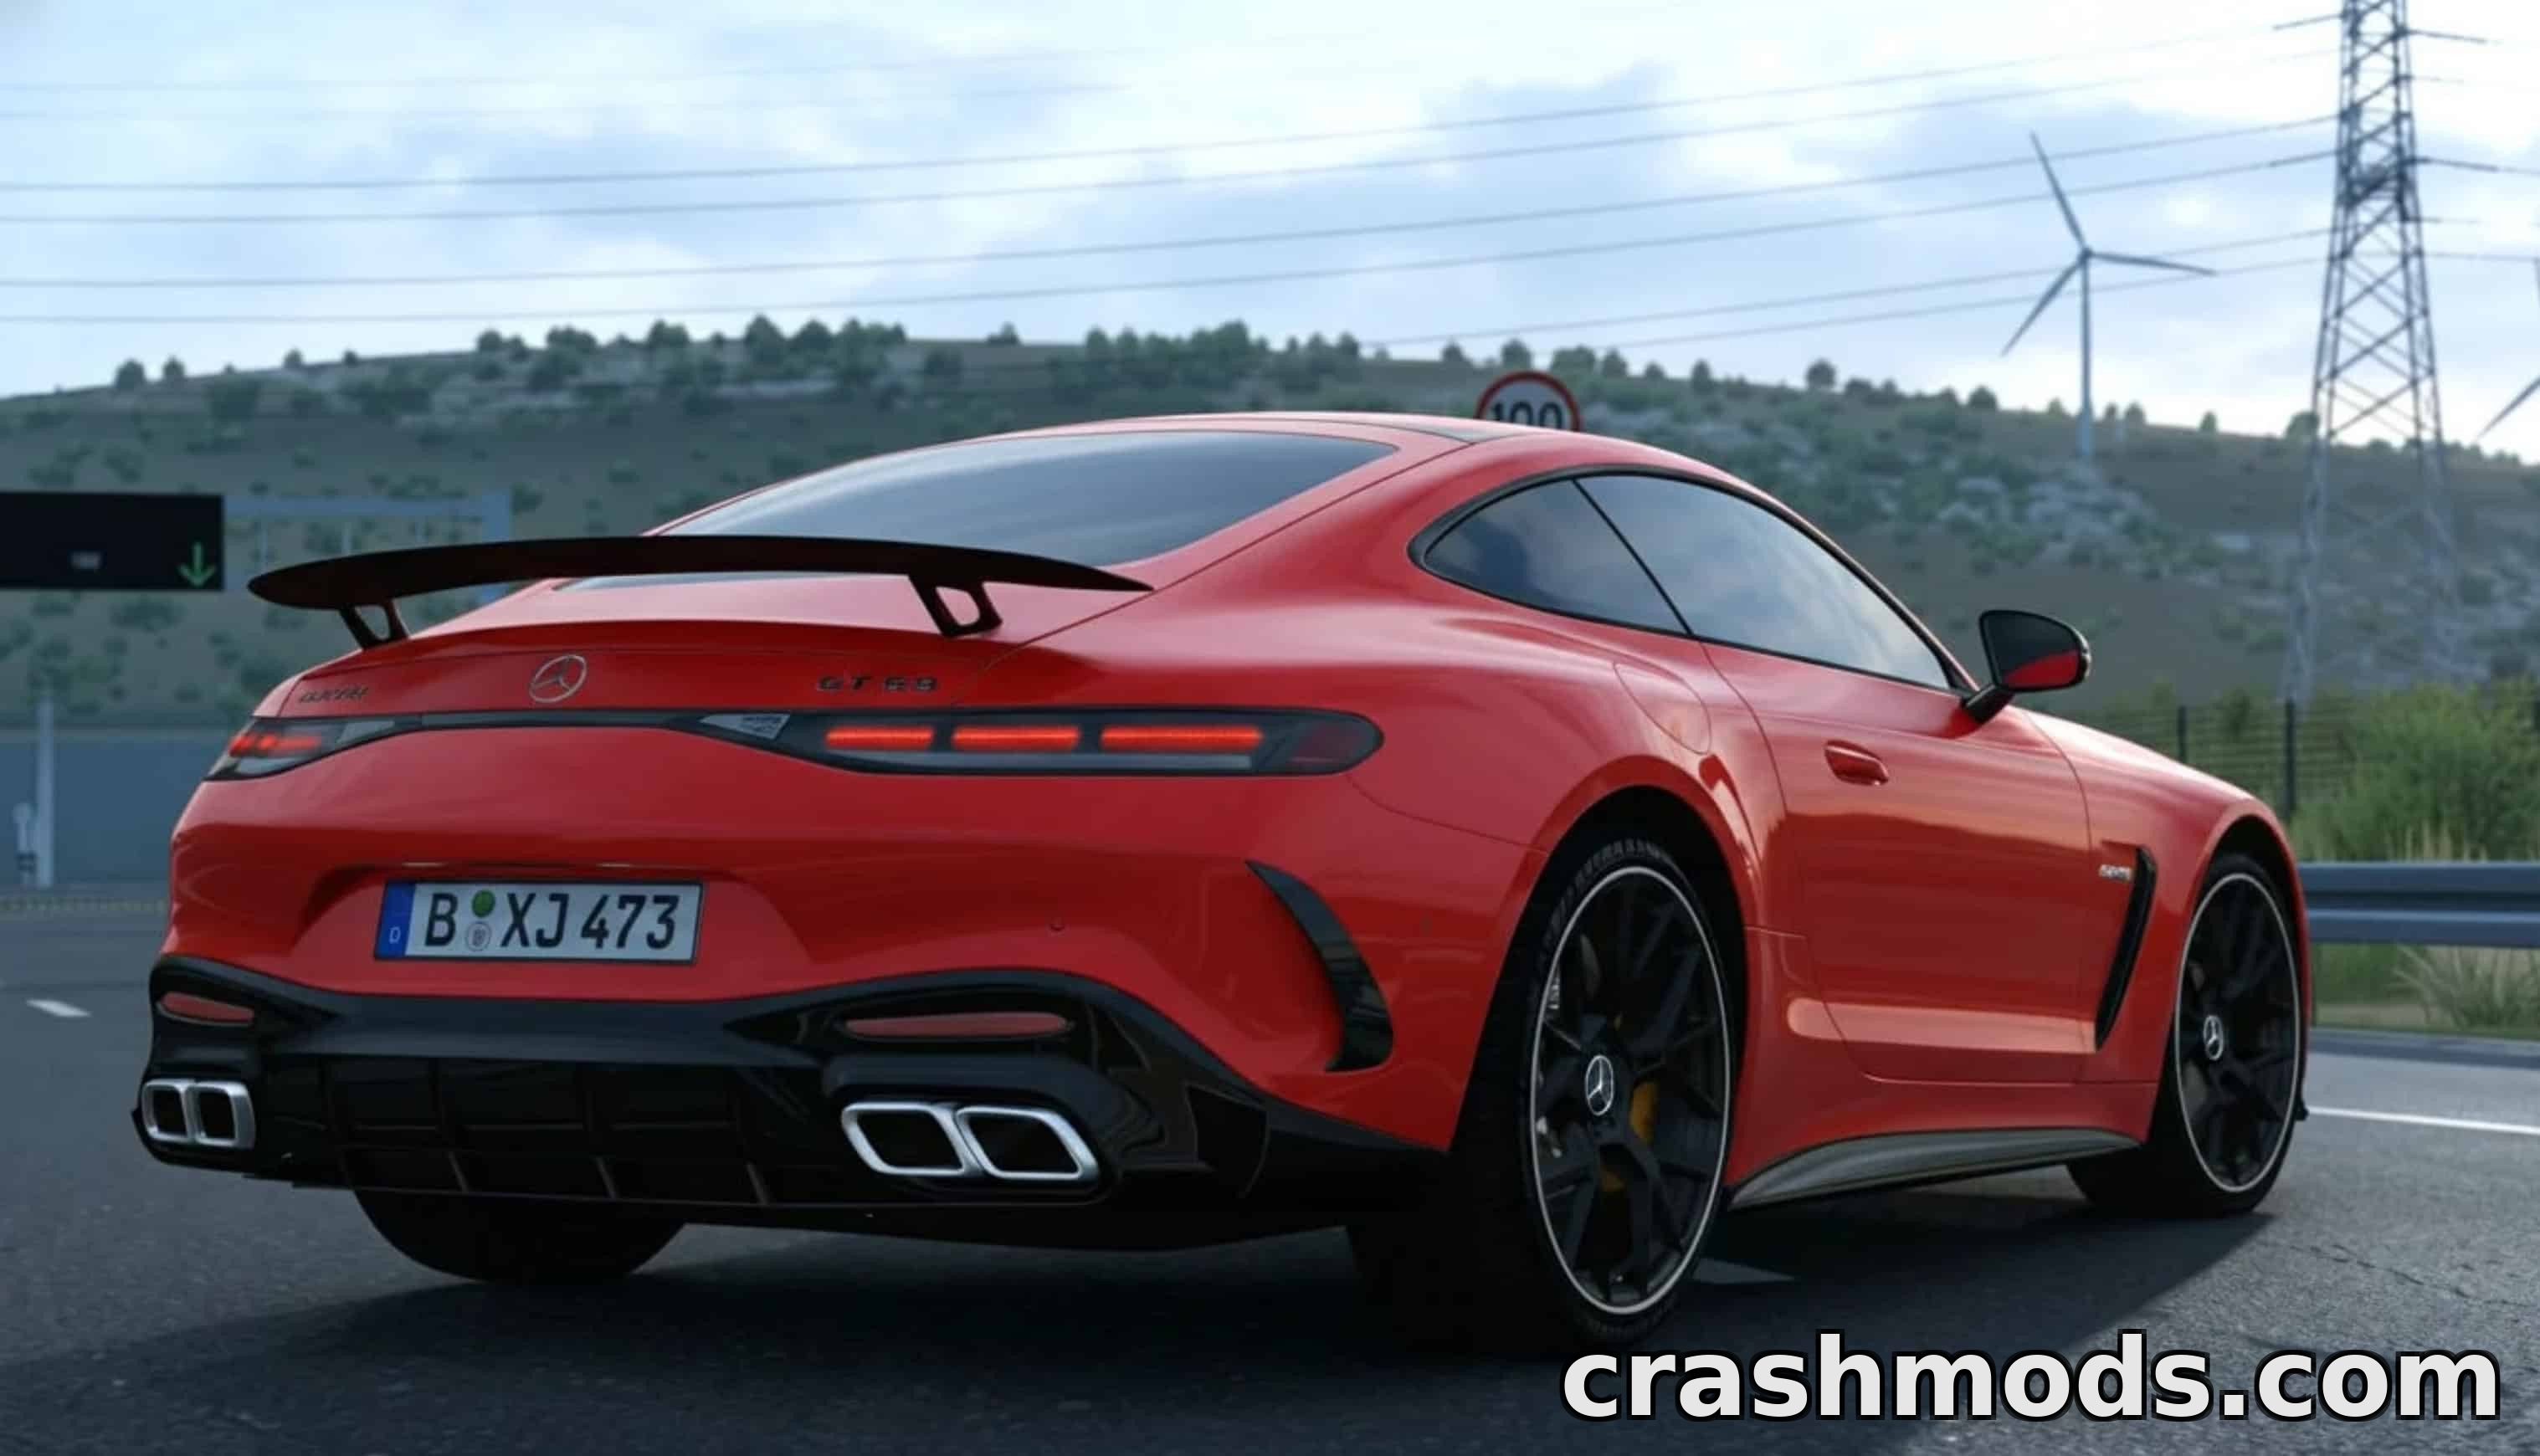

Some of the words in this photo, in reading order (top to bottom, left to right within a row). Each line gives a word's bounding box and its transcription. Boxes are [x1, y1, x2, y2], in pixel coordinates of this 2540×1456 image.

[388, 926, 401, 944] D
[424, 892, 459, 947] B
[500, 893, 570, 949] XJ
[581, 894, 680, 951] 473
